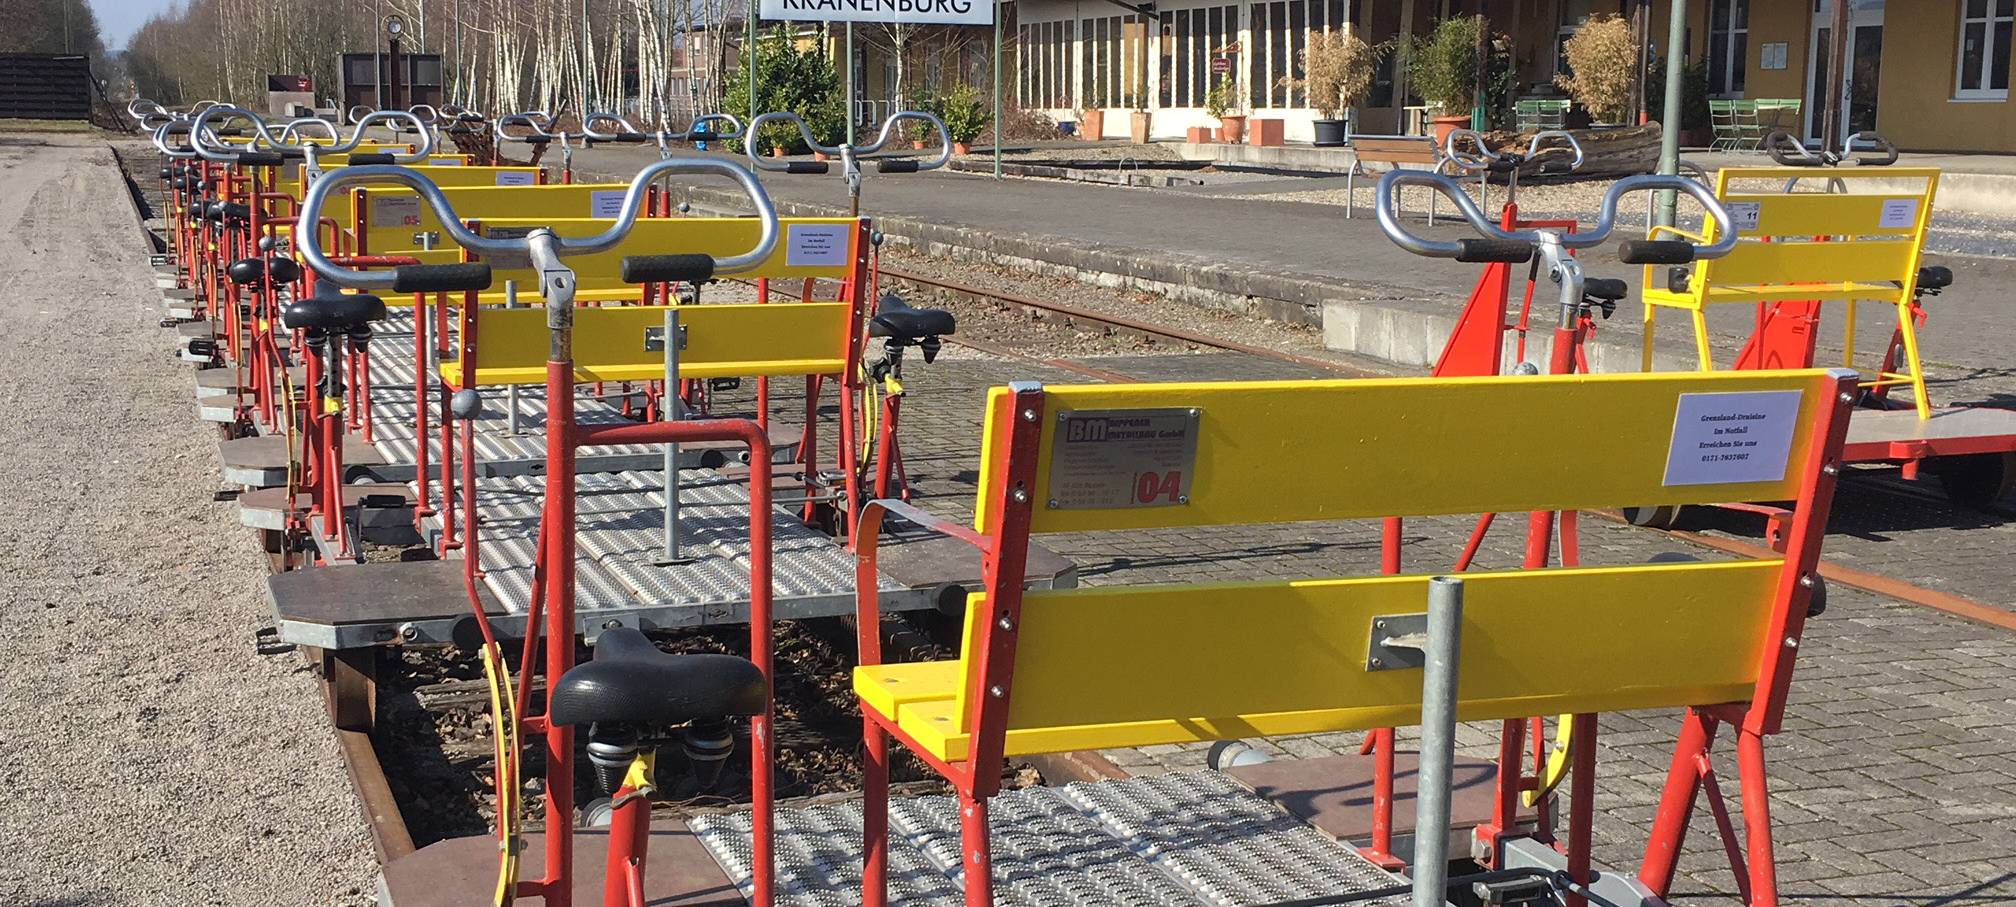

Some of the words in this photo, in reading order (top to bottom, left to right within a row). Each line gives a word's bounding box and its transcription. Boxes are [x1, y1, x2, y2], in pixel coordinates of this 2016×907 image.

[1747, 212, 1757, 220] 11
[1068, 419, 1107, 441] BM
[1725, 426, 1748, 434] Notfall
[1699, 440, 1732, 449] Erreichen
[1137, 471, 1182, 504] 04
